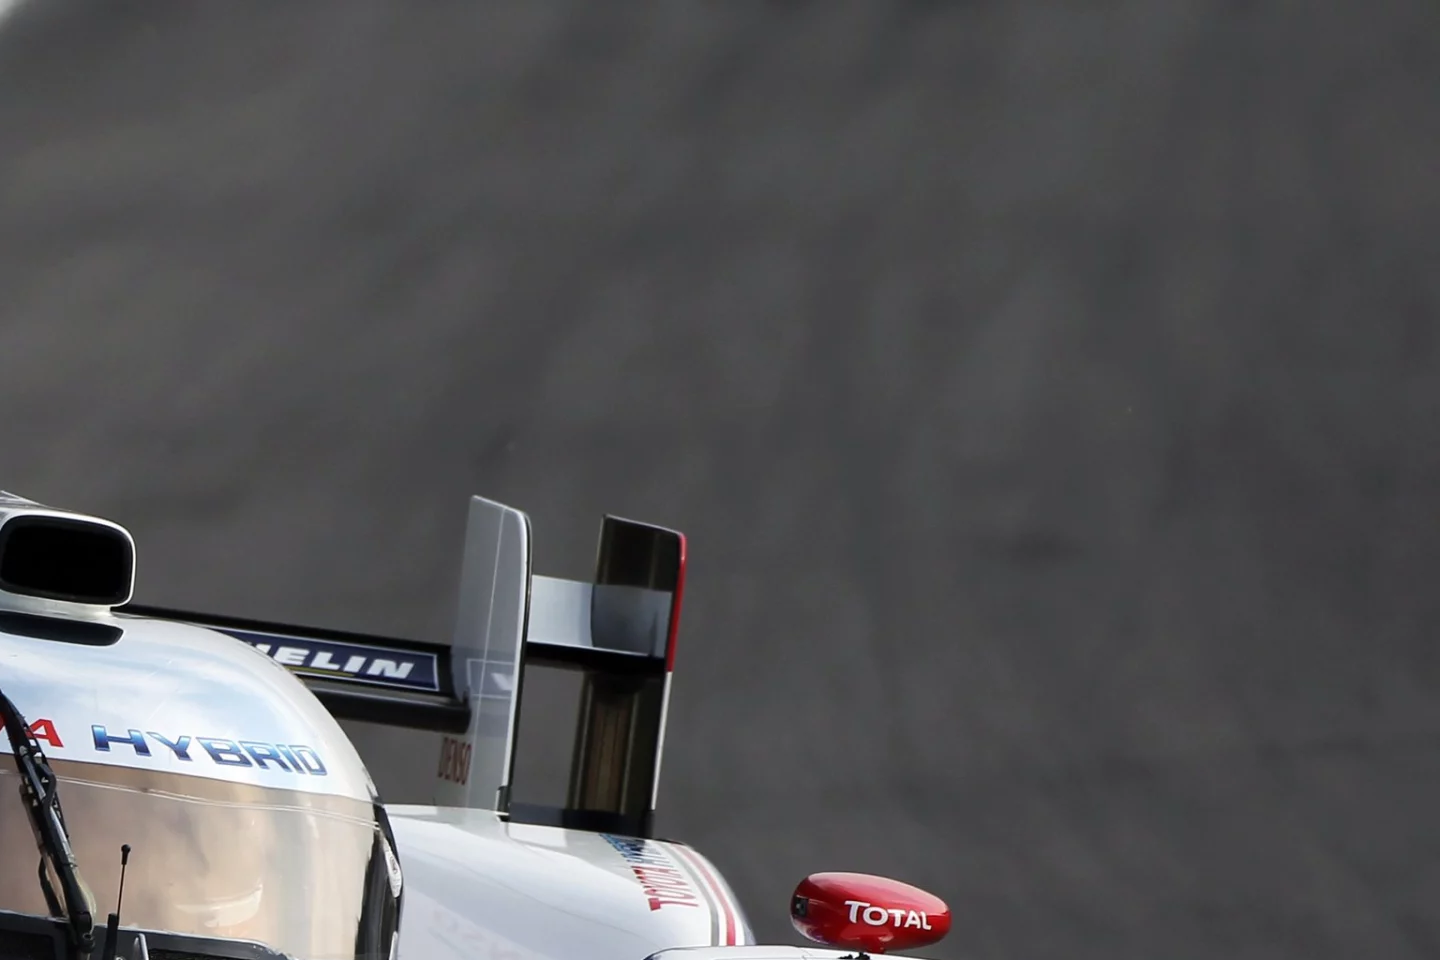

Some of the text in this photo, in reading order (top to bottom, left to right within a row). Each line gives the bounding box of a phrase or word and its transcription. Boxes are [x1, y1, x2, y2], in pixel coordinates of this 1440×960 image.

[256, 643, 414, 679] ELIN
[91, 725, 327, 776] HYBRID
[844, 900, 932, 931] TOTAL
